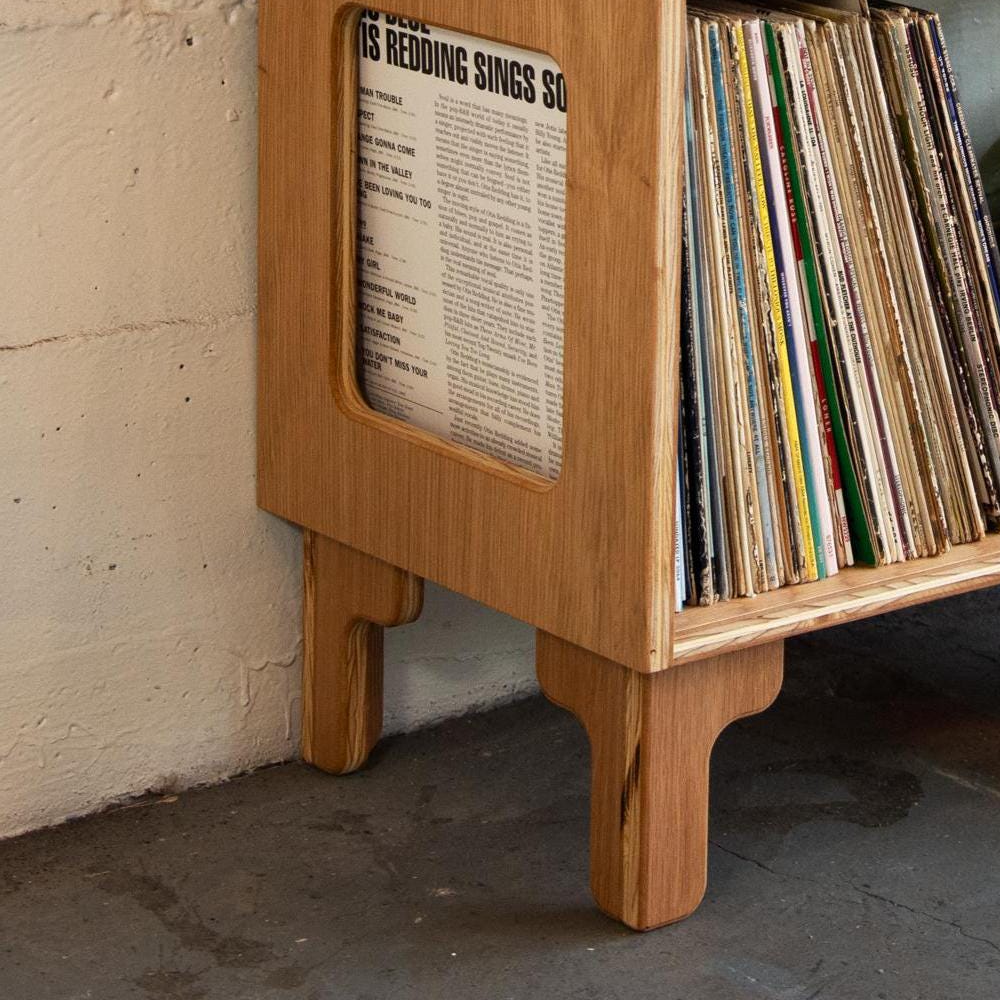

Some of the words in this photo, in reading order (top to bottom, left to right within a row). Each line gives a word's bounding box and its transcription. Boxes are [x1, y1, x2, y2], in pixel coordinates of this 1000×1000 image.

[360, 21, 381, 62] IS
[386, 27, 468, 85] REDDING
[474, 51, 536, 104] SINGS
[542, 69, 567, 113] SO
[798, 80, 805, 88] LA
[360, 86, 374, 98] MAN
[375, 90, 403, 106] TROUBLE
[360, 109, 375, 121] PECT
[374, 138, 395, 151] GONNA
[397, 144, 416, 157] COME
[922, 128, 934, 151] LIGHT
[377, 161, 390, 173] THE
[391, 165, 413, 179] VALLEY
[928, 154, 937, 167] and
[365, 181, 380, 193] BEEN
[381, 185, 403, 201] LOVING
[405, 194, 418, 205] YOU
[419, 197, 432, 209] TOO
[941, 212, 954, 250] CARNEGIE
[366, 257, 381, 271] GIRL
[950, 252, 959, 270] HALL
[837, 270, 845, 282] BUD
[394, 291, 417, 306] WORLD
[839, 283, 851, 309] FLETCHER
[958, 289, 971, 314] IRVING
[361, 303, 375, 315] OCK
[376, 307, 387, 318] ME
[387, 311, 404, 324] BABY
[845, 311, 853, 319] AT
[847, 320, 855, 331] THE
[964, 316, 977, 342] BERLIN
[849, 333, 861, 363] OUTHOUSE
[375, 350, 393, 366] DON'T
[394, 357, 411, 373] MISS
[411, 364, 428, 378] YOUR
[976, 363, 994, 418] STEREOPHONIC
[989, 420, 999, 438] DISC
